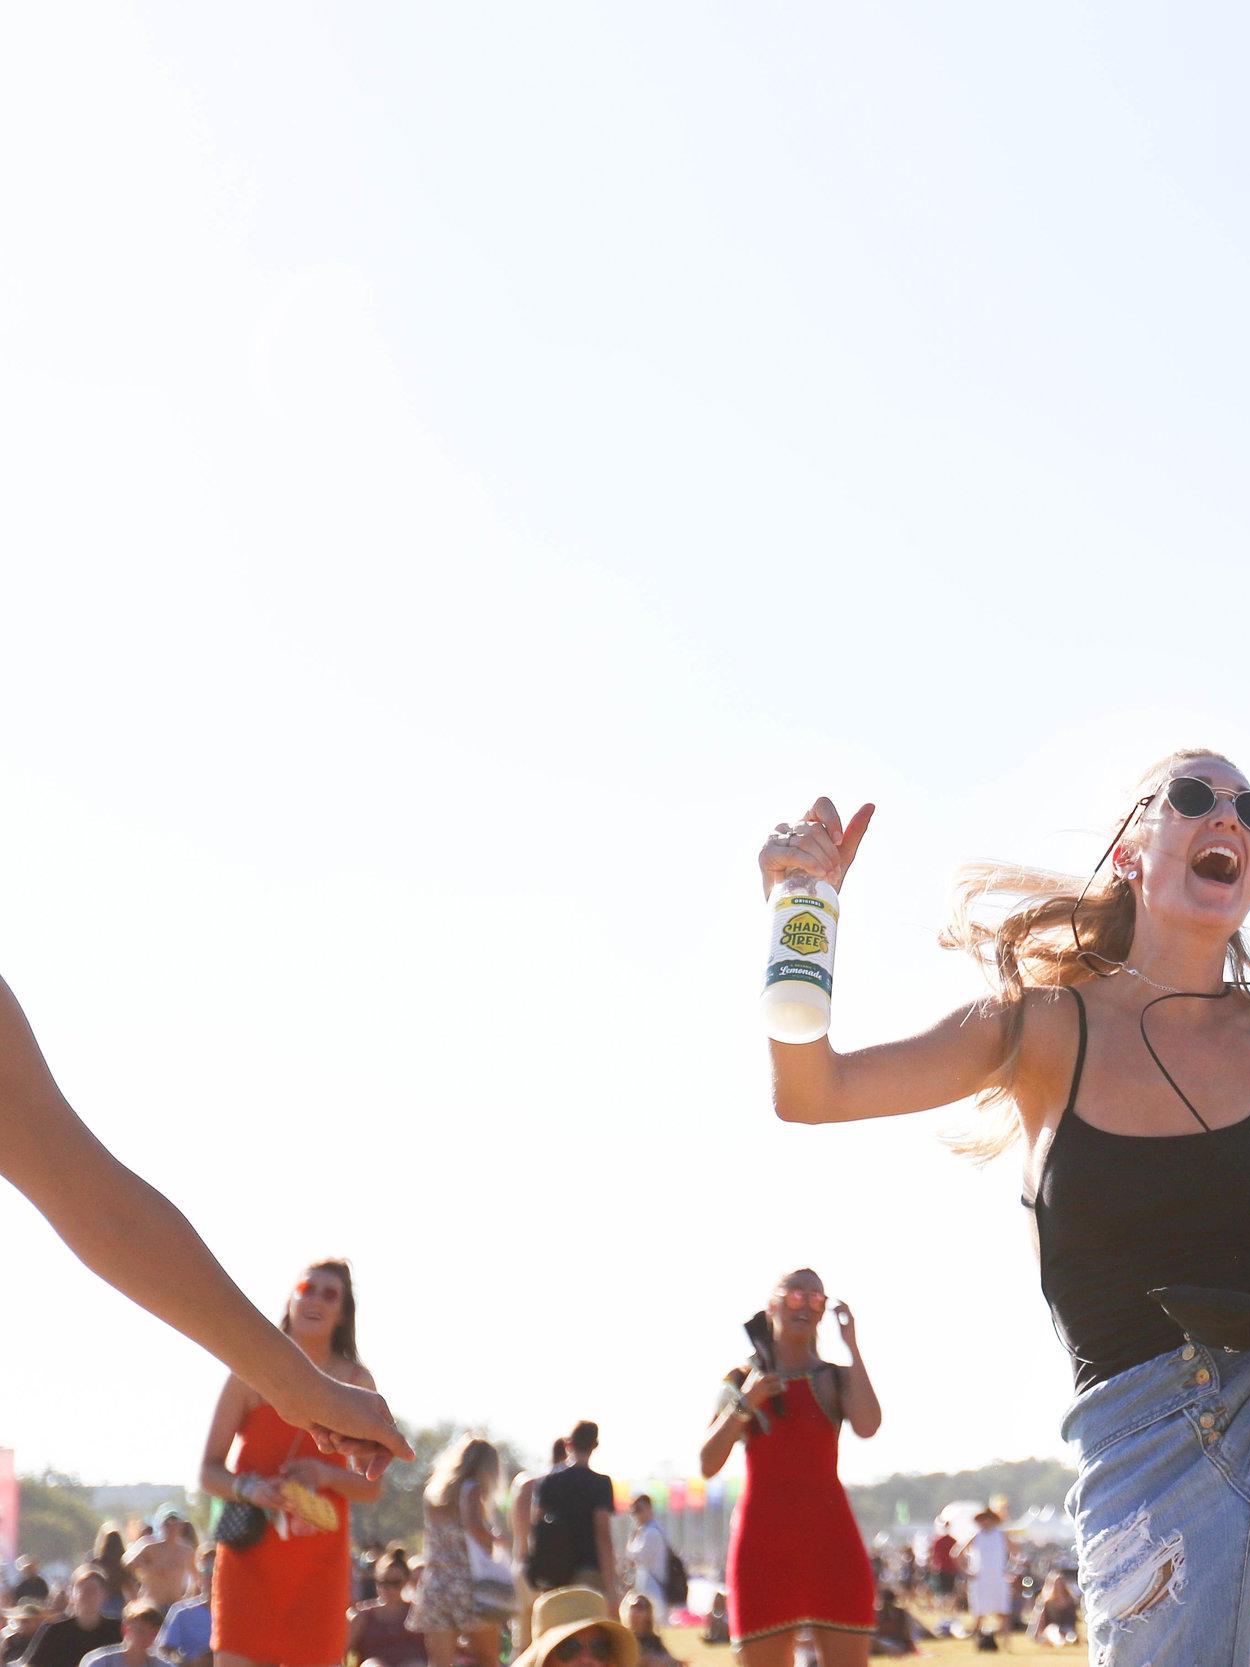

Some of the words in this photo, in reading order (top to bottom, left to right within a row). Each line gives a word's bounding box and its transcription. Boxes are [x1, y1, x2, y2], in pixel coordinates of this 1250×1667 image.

[780, 922, 827, 943] SHADE
[791, 933, 820, 947] TREE
[778, 965, 822, 980] Lemonade
